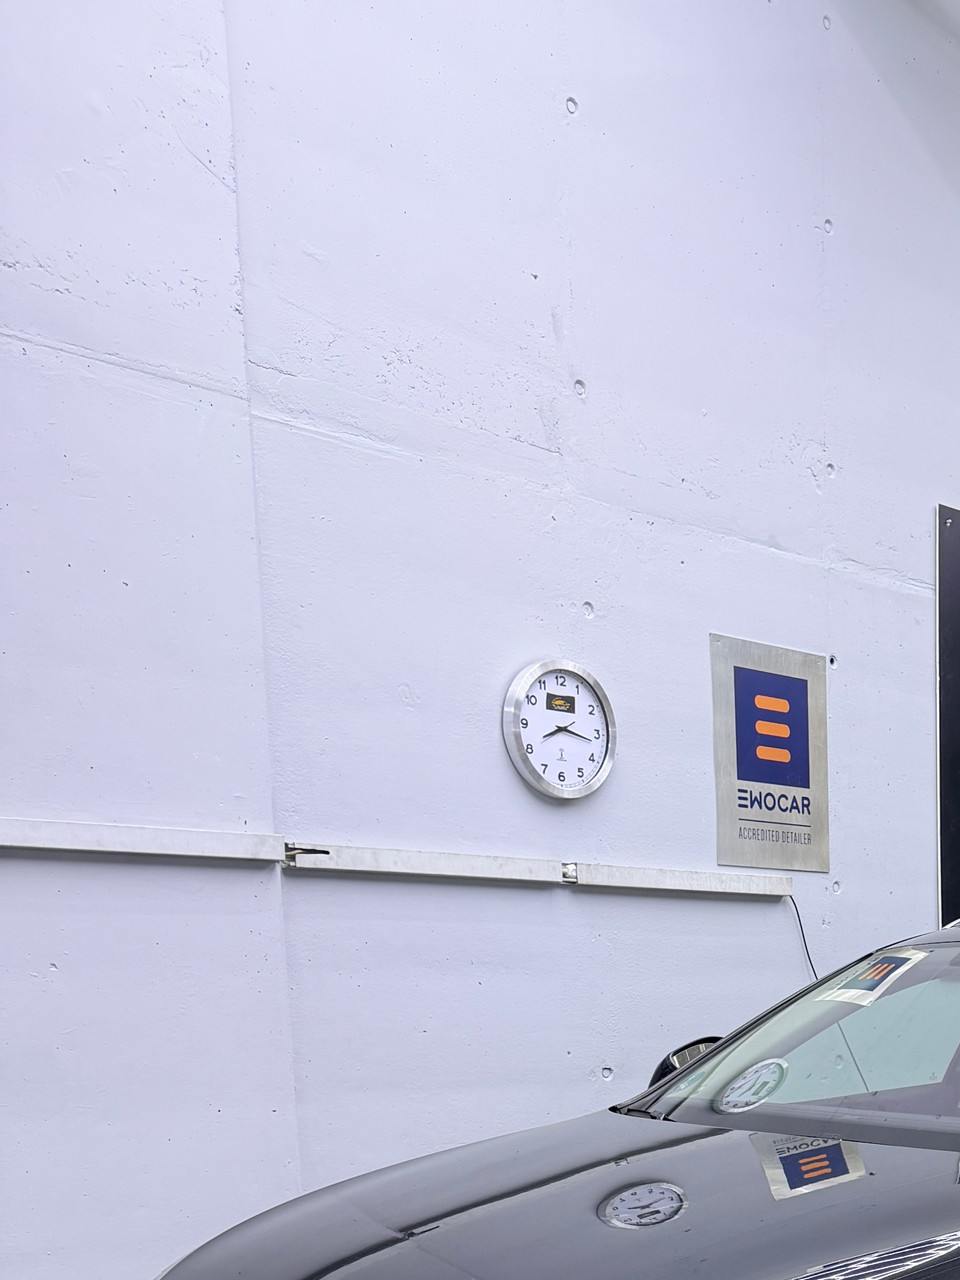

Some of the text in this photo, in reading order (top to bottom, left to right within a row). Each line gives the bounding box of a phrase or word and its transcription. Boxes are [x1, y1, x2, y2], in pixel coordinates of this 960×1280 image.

[538, 679, 546, 691] 11
[555, 675, 567, 687] 12
[575, 684, 580, 695] 1
[526, 694, 537, 706] 10
[588, 705, 595, 715] 2
[520, 718, 528, 729] 9
[593, 729, 600, 740] 3
[525, 743, 534, 754] 8
[588, 753, 595, 763] 4
[540, 763, 548, 774] 7
[577, 767, 584, 778] 5
[558, 771, 566, 782] 6
[737, 788, 811, 815] EWOCAR
[738, 826, 812, 845] ACCREDITED DETAILER
